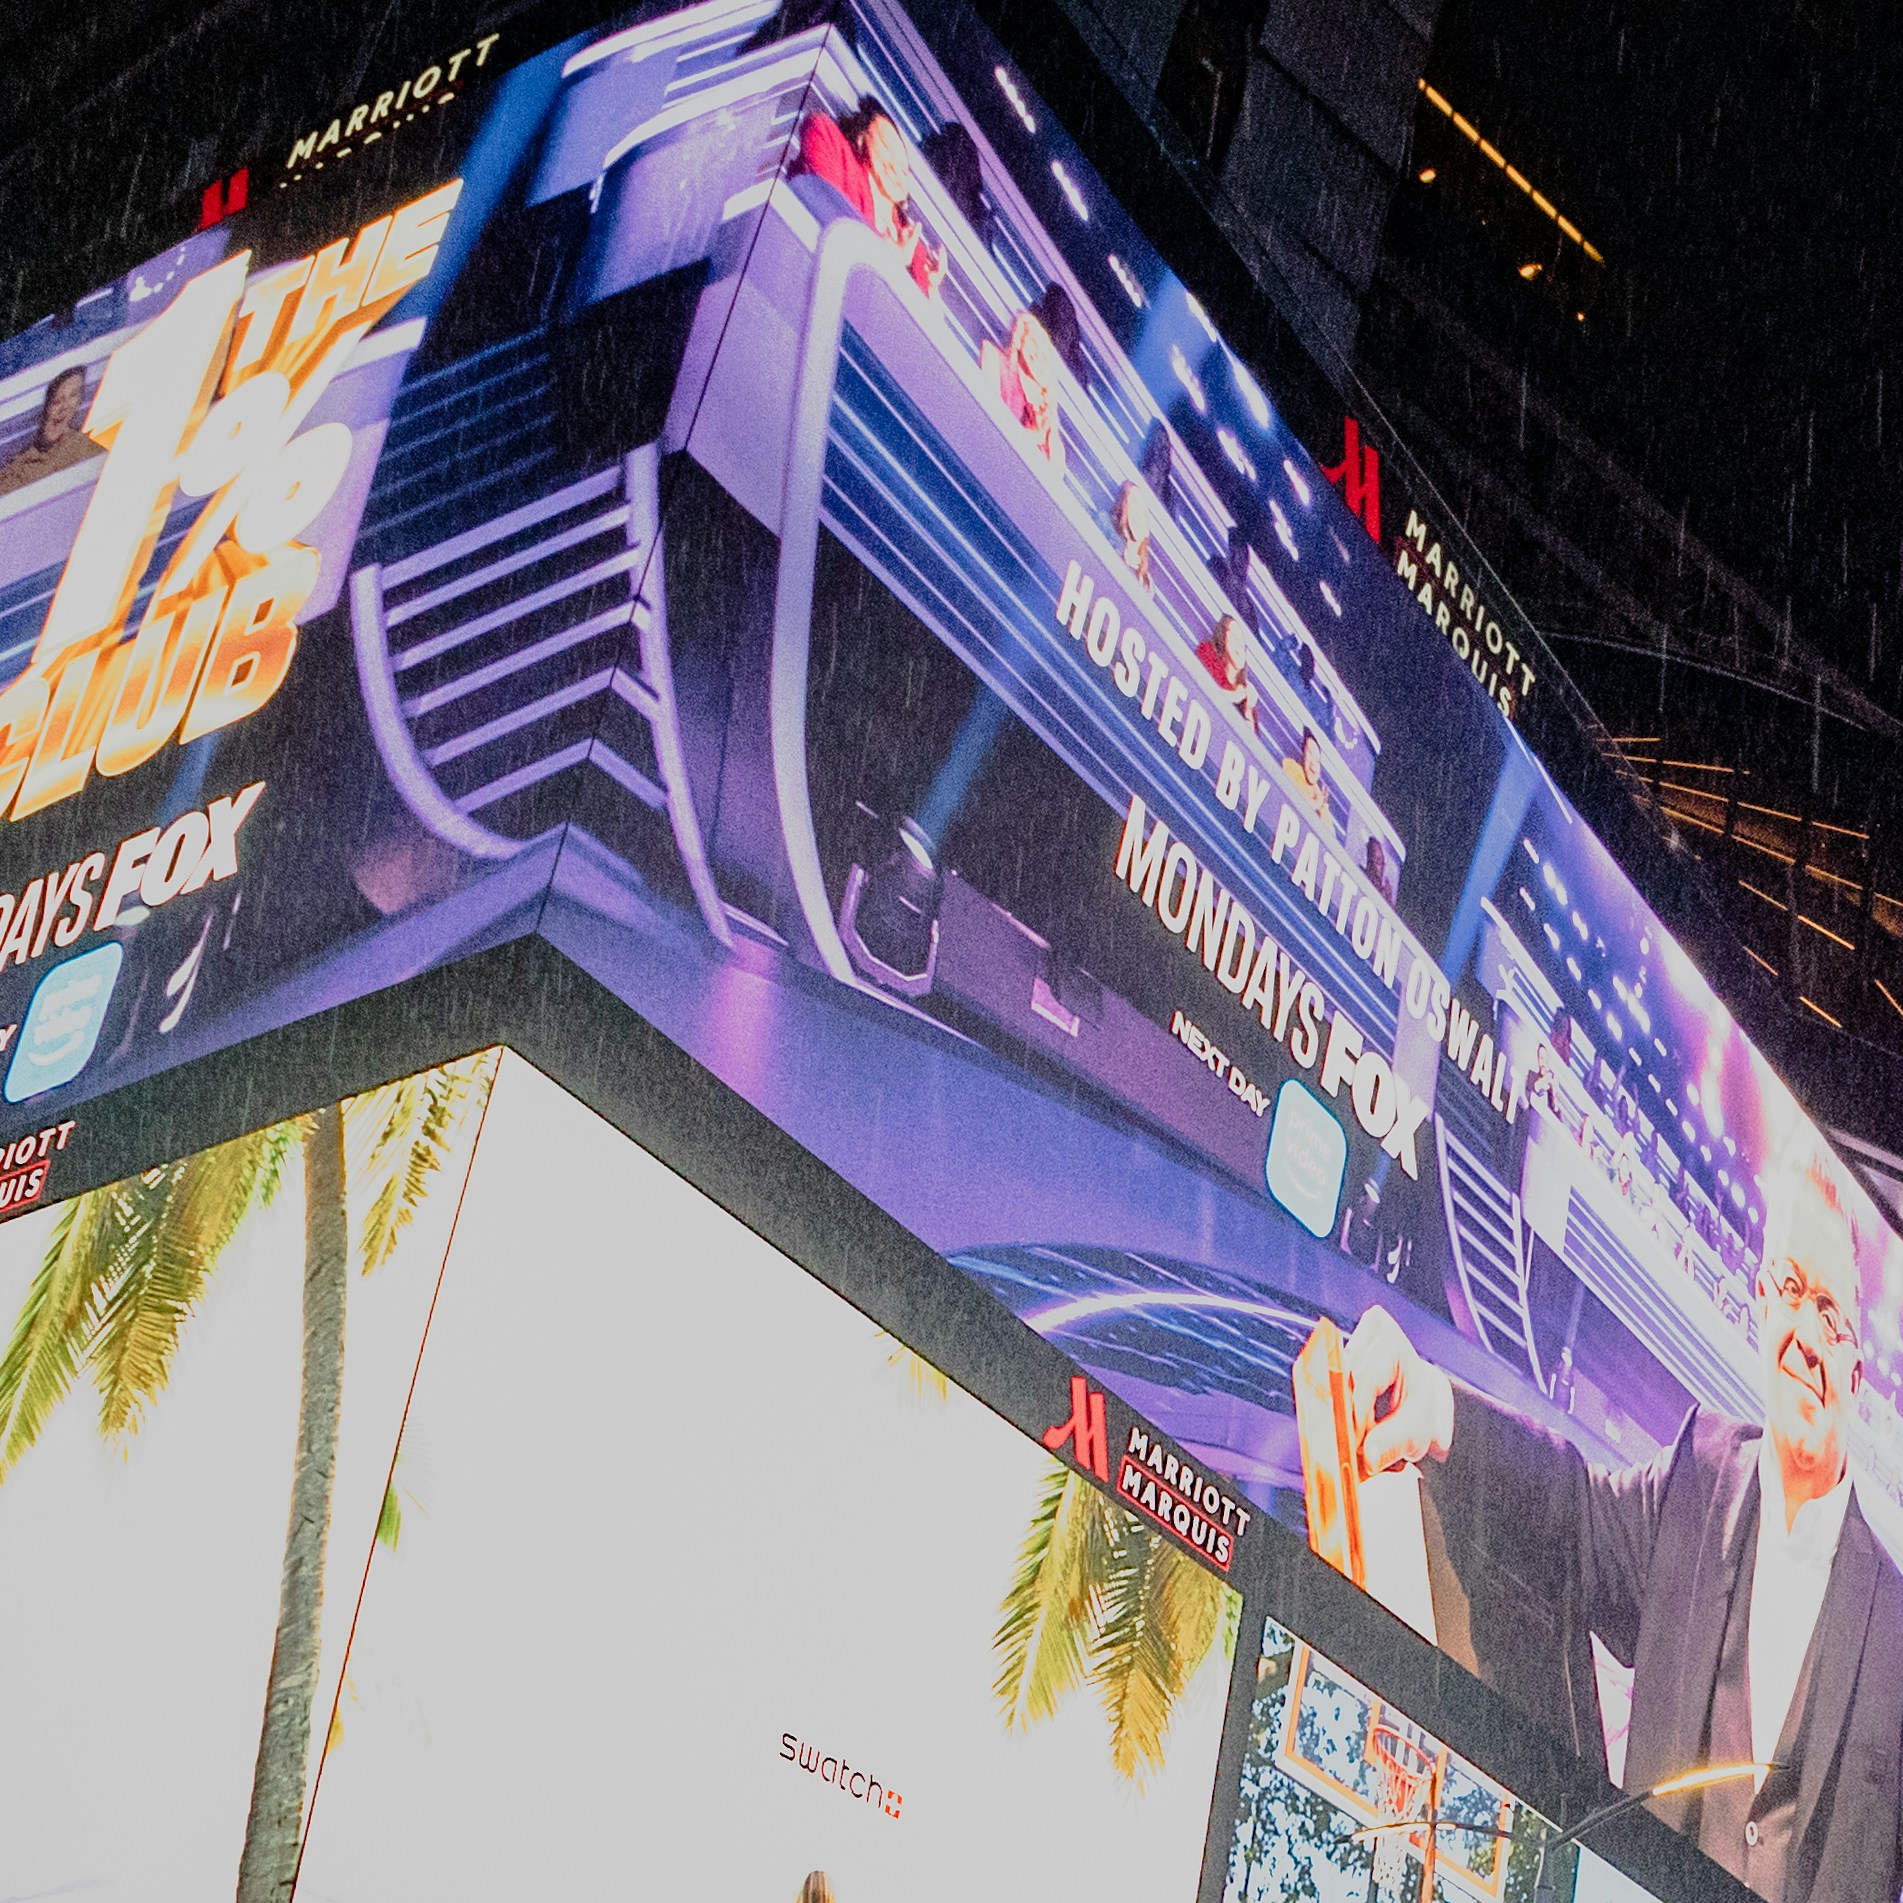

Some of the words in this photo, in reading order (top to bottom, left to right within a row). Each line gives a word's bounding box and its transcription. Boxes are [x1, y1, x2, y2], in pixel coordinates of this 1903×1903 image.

[287, 33, 500, 169] MARRIOTT
[236, 178, 464, 369] THE
[1397, 551, 1513, 719] MARQUIS
[1405, 509, 1536, 696] MARRIOTT
[0, 541, 318, 822] CLUB
[94, 781, 265, 931] FOX
[1055, 560, 1210, 770] HOSTED
[1215, 764, 1270, 833] BY
[1271, 810, 1399, 989] PATTON
[1405, 965, 1529, 1124] OSWALT
[1114, 793, 1327, 1069] MONDAYS
[1320, 1011, 1429, 1180] FOX
[1172, 1011, 1231, 1077] NEXT
[1228, 1065, 1271, 1117] DAY
[0, 1121, 76, 1172] IOTT
[1120, 1464, 1231, 1564] MARQUIS
[1127, 1428, 1250, 1537] MARRIOTT
[781, 1731, 887, 1811] swatch
